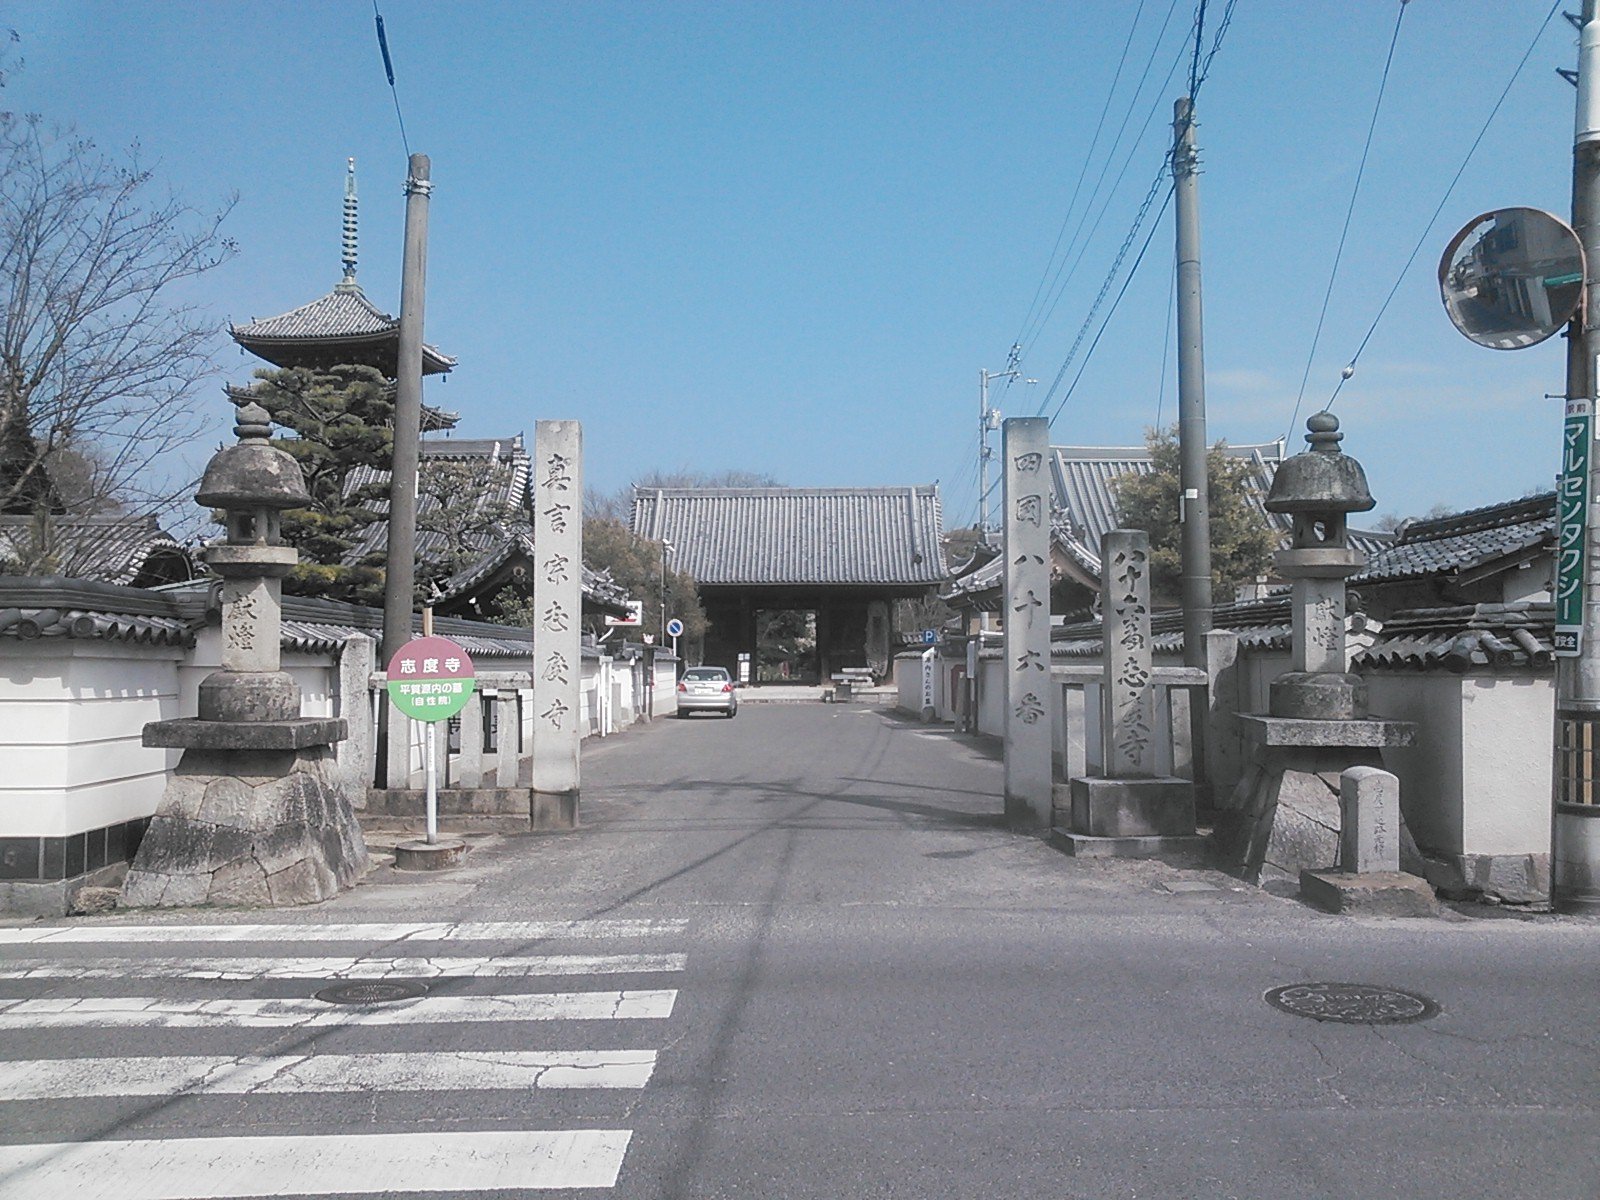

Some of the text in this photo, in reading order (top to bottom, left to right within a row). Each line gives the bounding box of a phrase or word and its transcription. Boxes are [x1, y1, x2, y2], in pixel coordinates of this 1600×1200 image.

[1558, 423, 1585, 620] マルセンタクシー
[925, 630, 933, 642] P
[400, 657, 460, 674] 志度寺
[400, 682, 463, 695] 平賀源内の墓
